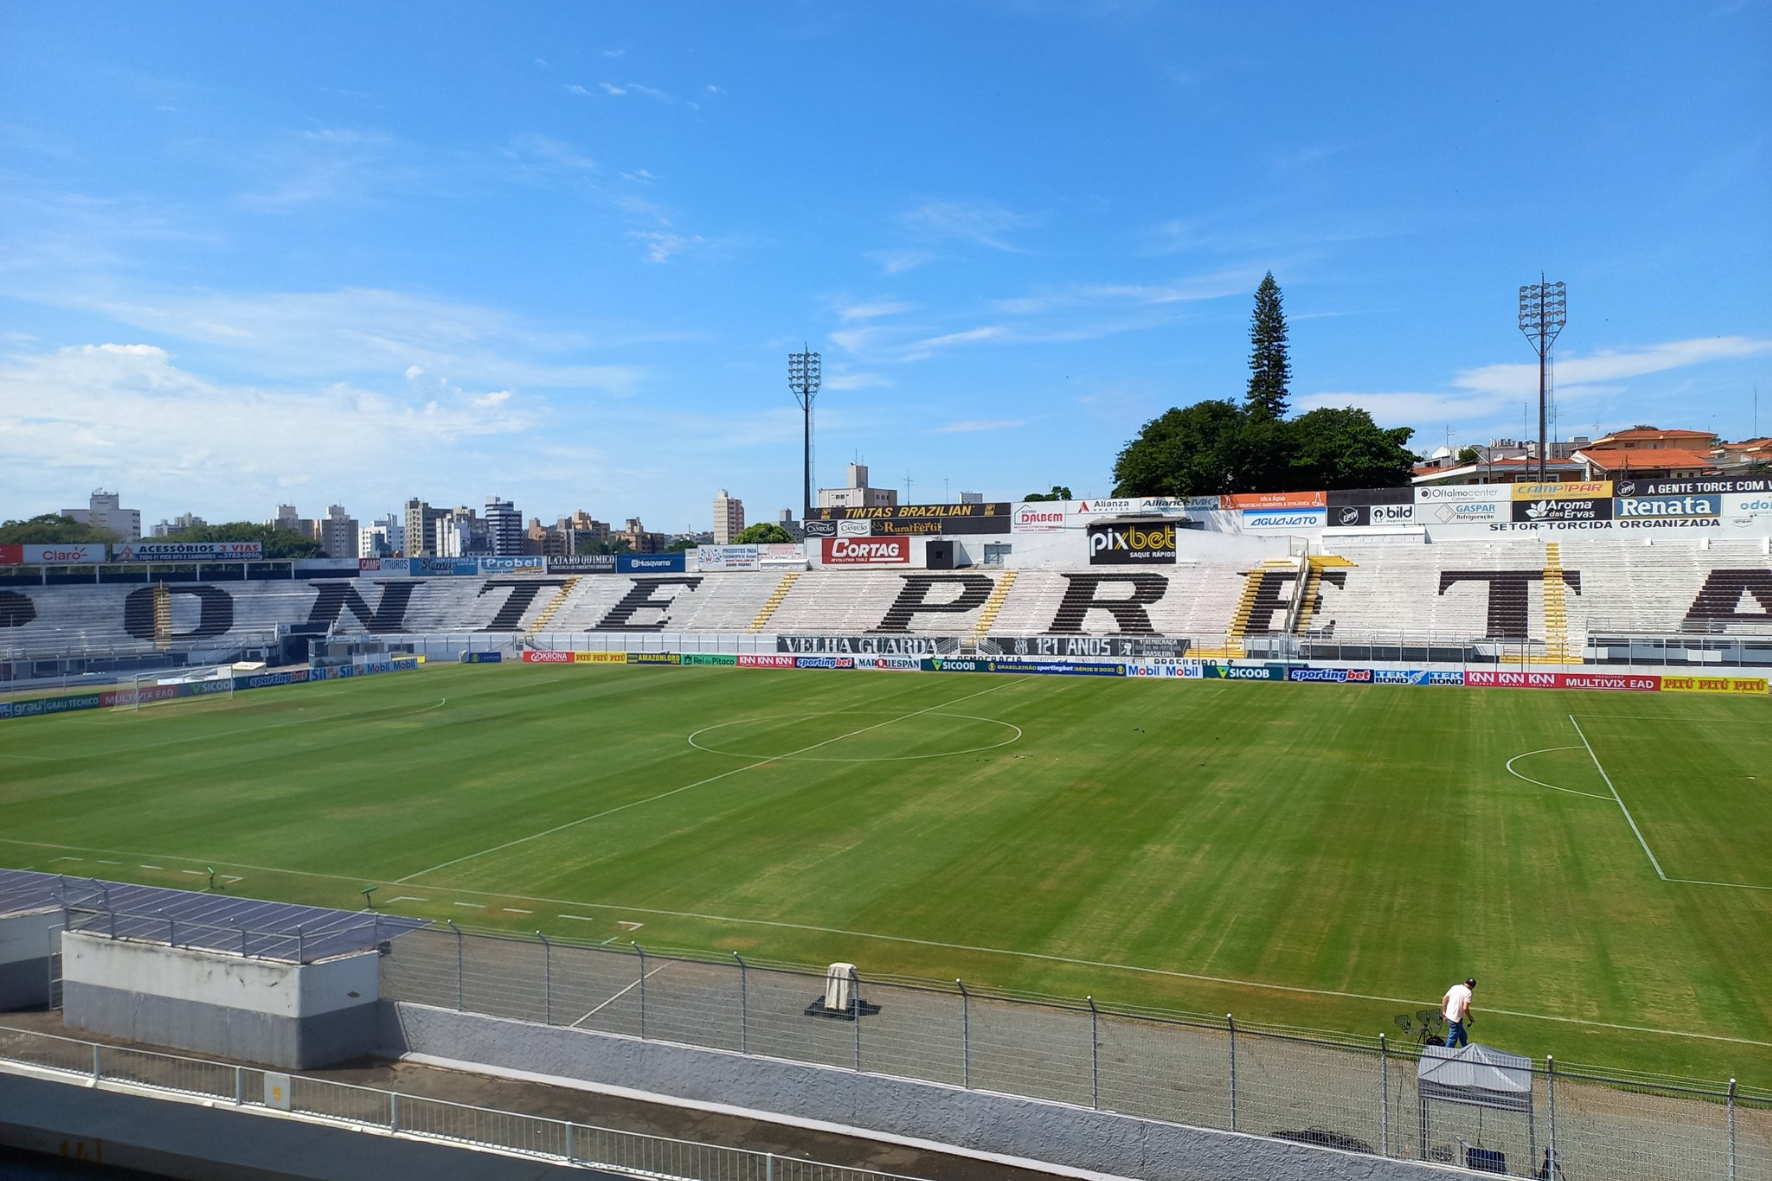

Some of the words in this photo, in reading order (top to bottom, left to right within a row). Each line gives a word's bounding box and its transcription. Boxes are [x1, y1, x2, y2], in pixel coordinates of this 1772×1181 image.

[1648, 485, 1655, 494] A
[1658, 484, 1693, 493] GENTE
[1696, 482, 1732, 492] TORCE
[1736, 481, 1764, 490] COM
[1432, 489, 1498, 497] Oftalmocenter
[1546, 500, 1592, 510] Aroma
[1620, 497, 1712, 516] Renata
[845, 507, 893, 518] TINTAS
[898, 505, 972, 517] BRAZILIAN
[1387, 506, 1412, 518] bild
[1564, 510, 1595, 518] Ervas
[1021, 513, 1063, 522] DALBEM
[1620, 519, 1721, 529] ORGANIZADA
[1090, 525, 1176, 557] pixbet
[139, 544, 215, 553] ACESSÓRIOS
[231, 543, 259, 552] VIAS
[831, 538, 900, 557] CORTAG
[42, 549, 81, 560] Claro
[1152, 550, 1175, 558] RÁPIDO
[361, 560, 380, 570] CAMP
[486, 558, 537, 568] Probel
[639, 560, 671, 568] Husqvarna
[784, 637, 853, 654] VELHA
[858, 637, 939, 655] GUARDA
[1036, 638, 1058, 655] 121
[1067, 638, 1111, 656] ANOS
[543, 652, 567, 660] KRONA
[712, 657, 735, 665] Pitaco
[740, 656, 756, 664] KNN
[758, 656, 774, 664] KNN
[776, 656, 792, 665] KNN
[394, 660, 416, 670] Mobil
[797, 657, 852, 668] sportingbet
[858, 657, 920, 668] MARQUESPAN
[942, 661, 976, 671] SICOOB
[367, 663, 390, 673] Mobil
[1037, 664, 1073, 672] sportingbet
[1128, 665, 1160, 675] Mobil
[1166, 666, 1198, 676] Mobil
[1229, 668, 1270, 678] SICOOB
[250, 671, 308, 687] sportingbet
[1291, 669, 1371, 682] sportingbet
[1468, 672, 1495, 683] KNN
[1498, 673, 1524, 684] KNN
[1528, 673, 1555, 684] KNN
[1565, 678, 1626, 687] MULTIVIX
[1630, 679, 1654, 689] EAD
[14, 701, 42, 716] grau
[46, 700, 68, 710] GRAU
[69, 697, 99, 708] TÉCNICO
